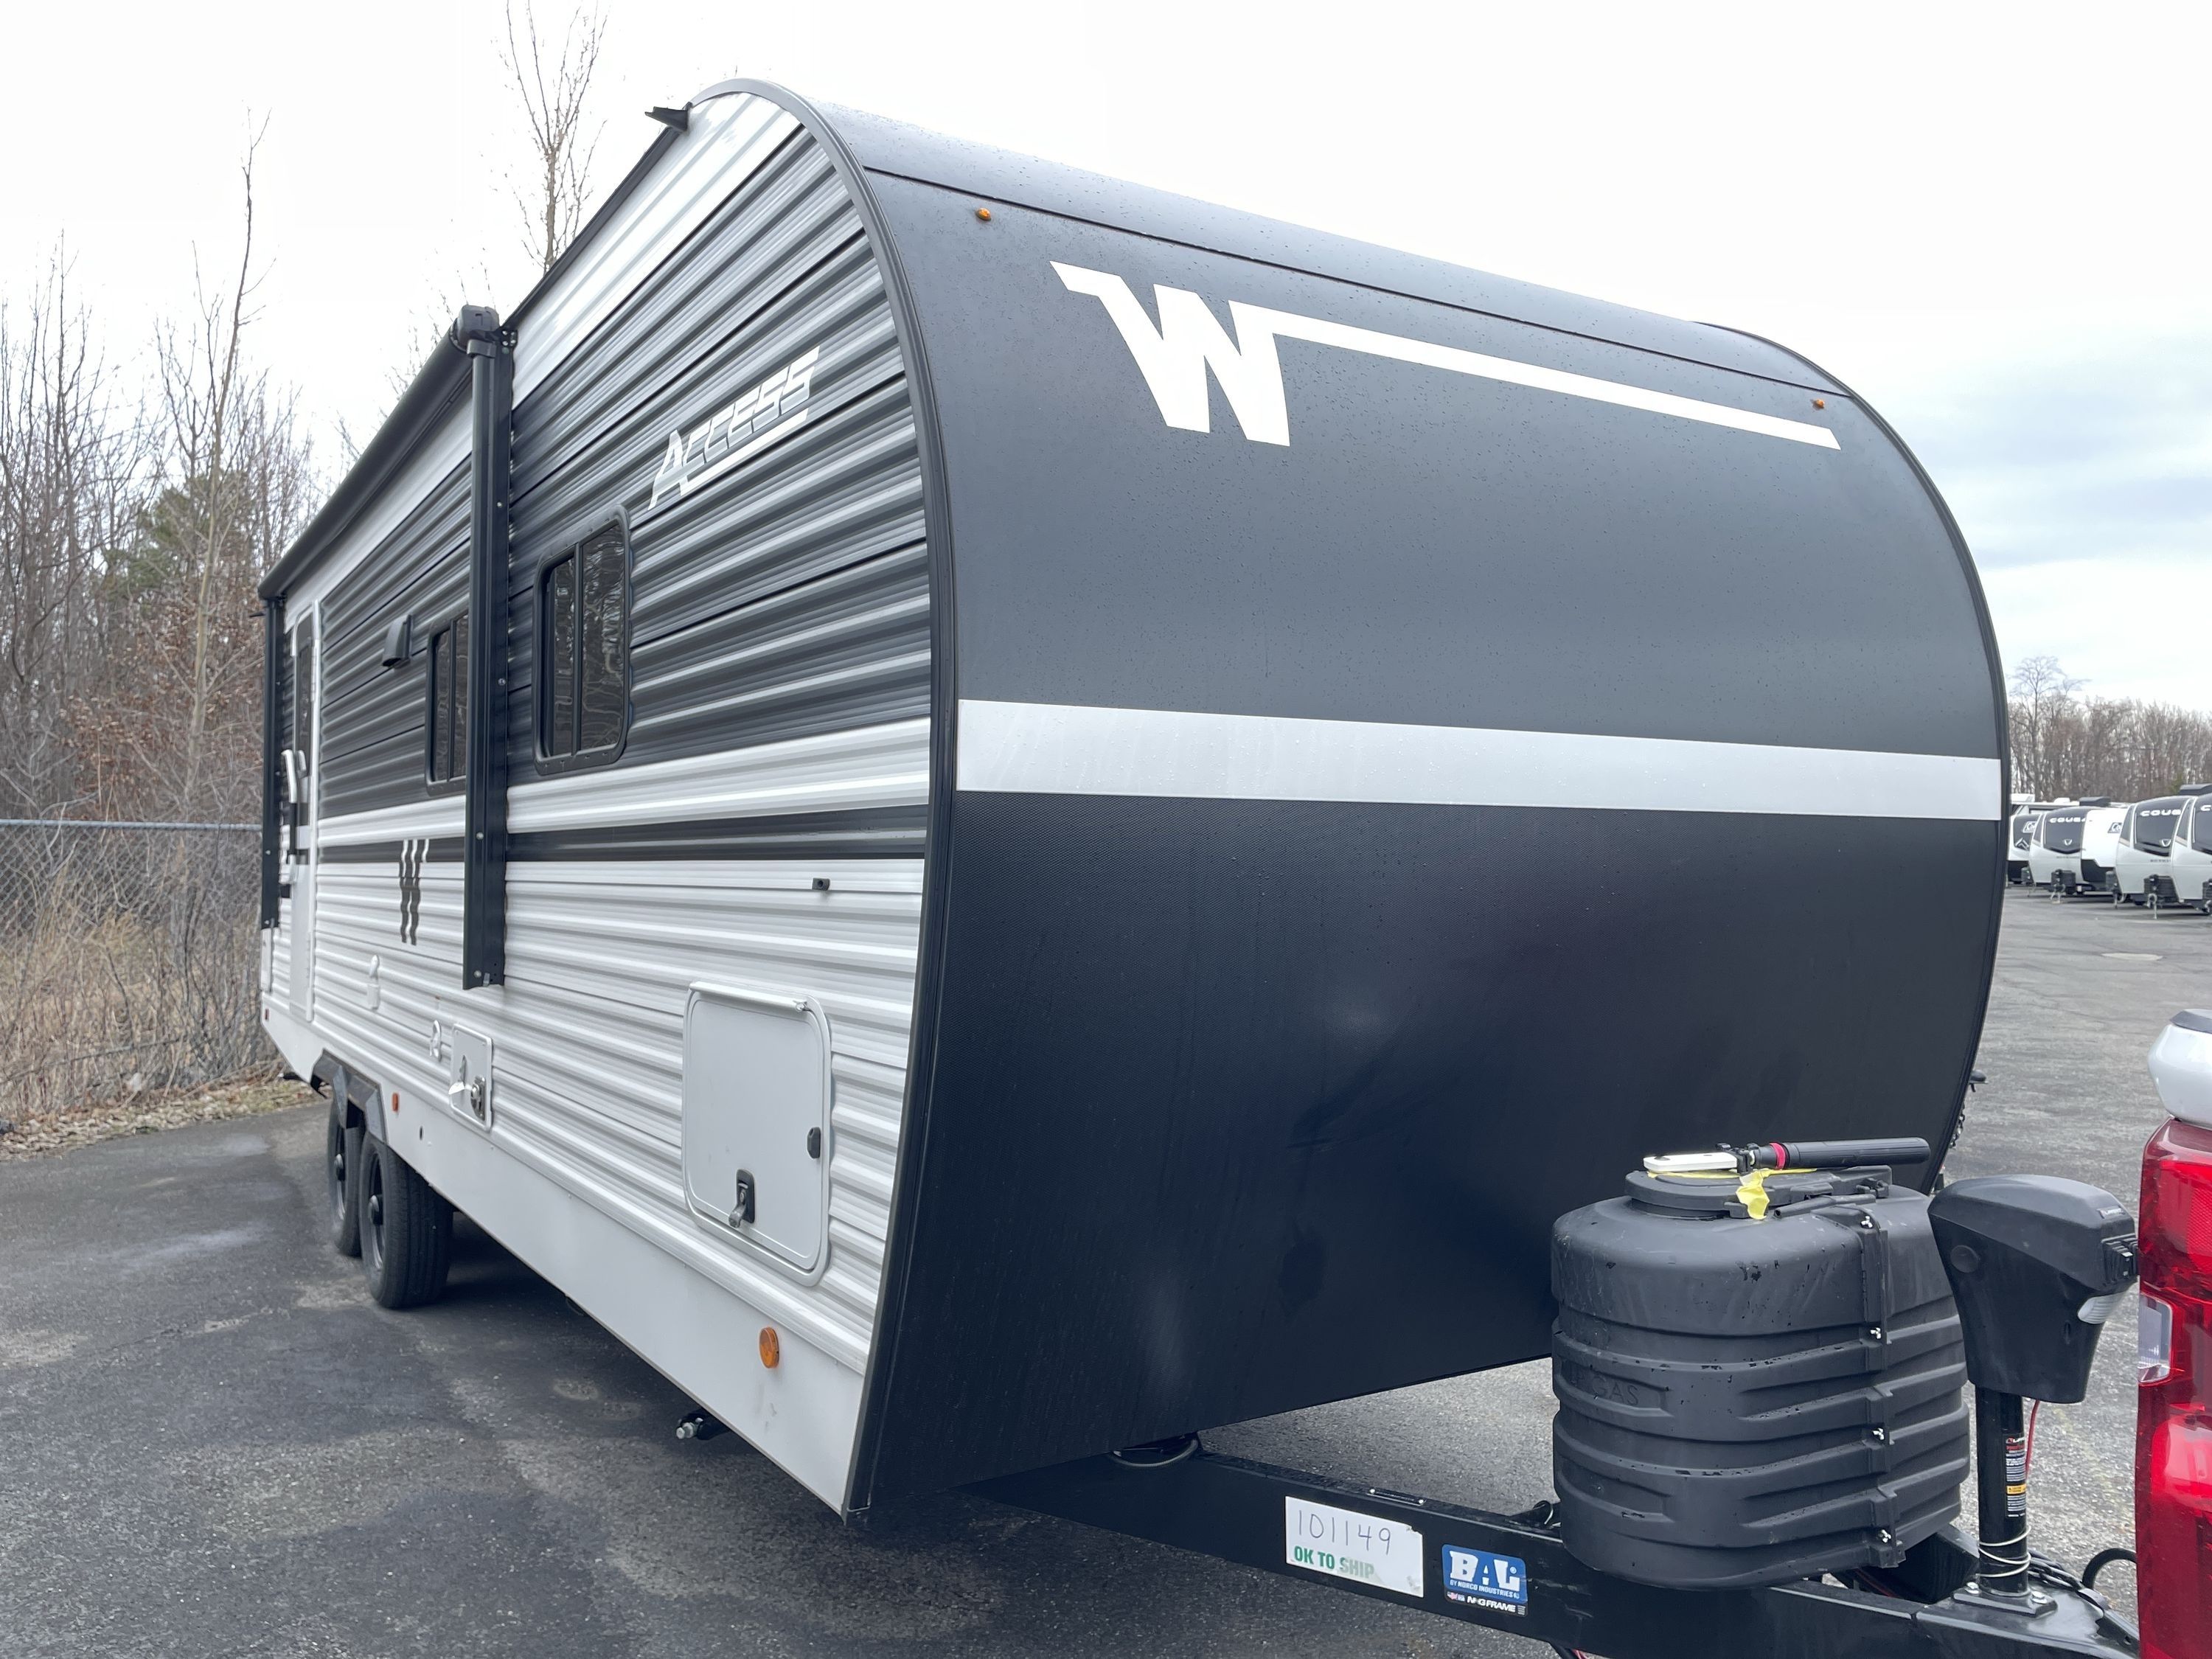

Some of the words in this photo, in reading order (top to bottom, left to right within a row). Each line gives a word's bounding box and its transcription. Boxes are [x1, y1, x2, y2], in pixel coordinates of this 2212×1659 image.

[2140, 809, 2181, 817] COUG
[1592, 1374, 1639, 1406] GAS
[1298, 1510, 1391, 1556] 101149
[1294, 1545, 1315, 1565] OK
[1318, 1551, 1335, 1570] TO
[1339, 1557, 1375, 1579] SHIP
[1449, 1550, 1520, 1592] BAL
[1458, 1581, 1478, 1591] NORCO
[1478, 1585, 1514, 1599] INDUSTRIES
[1486, 1600, 1517, 1613] FRAME
